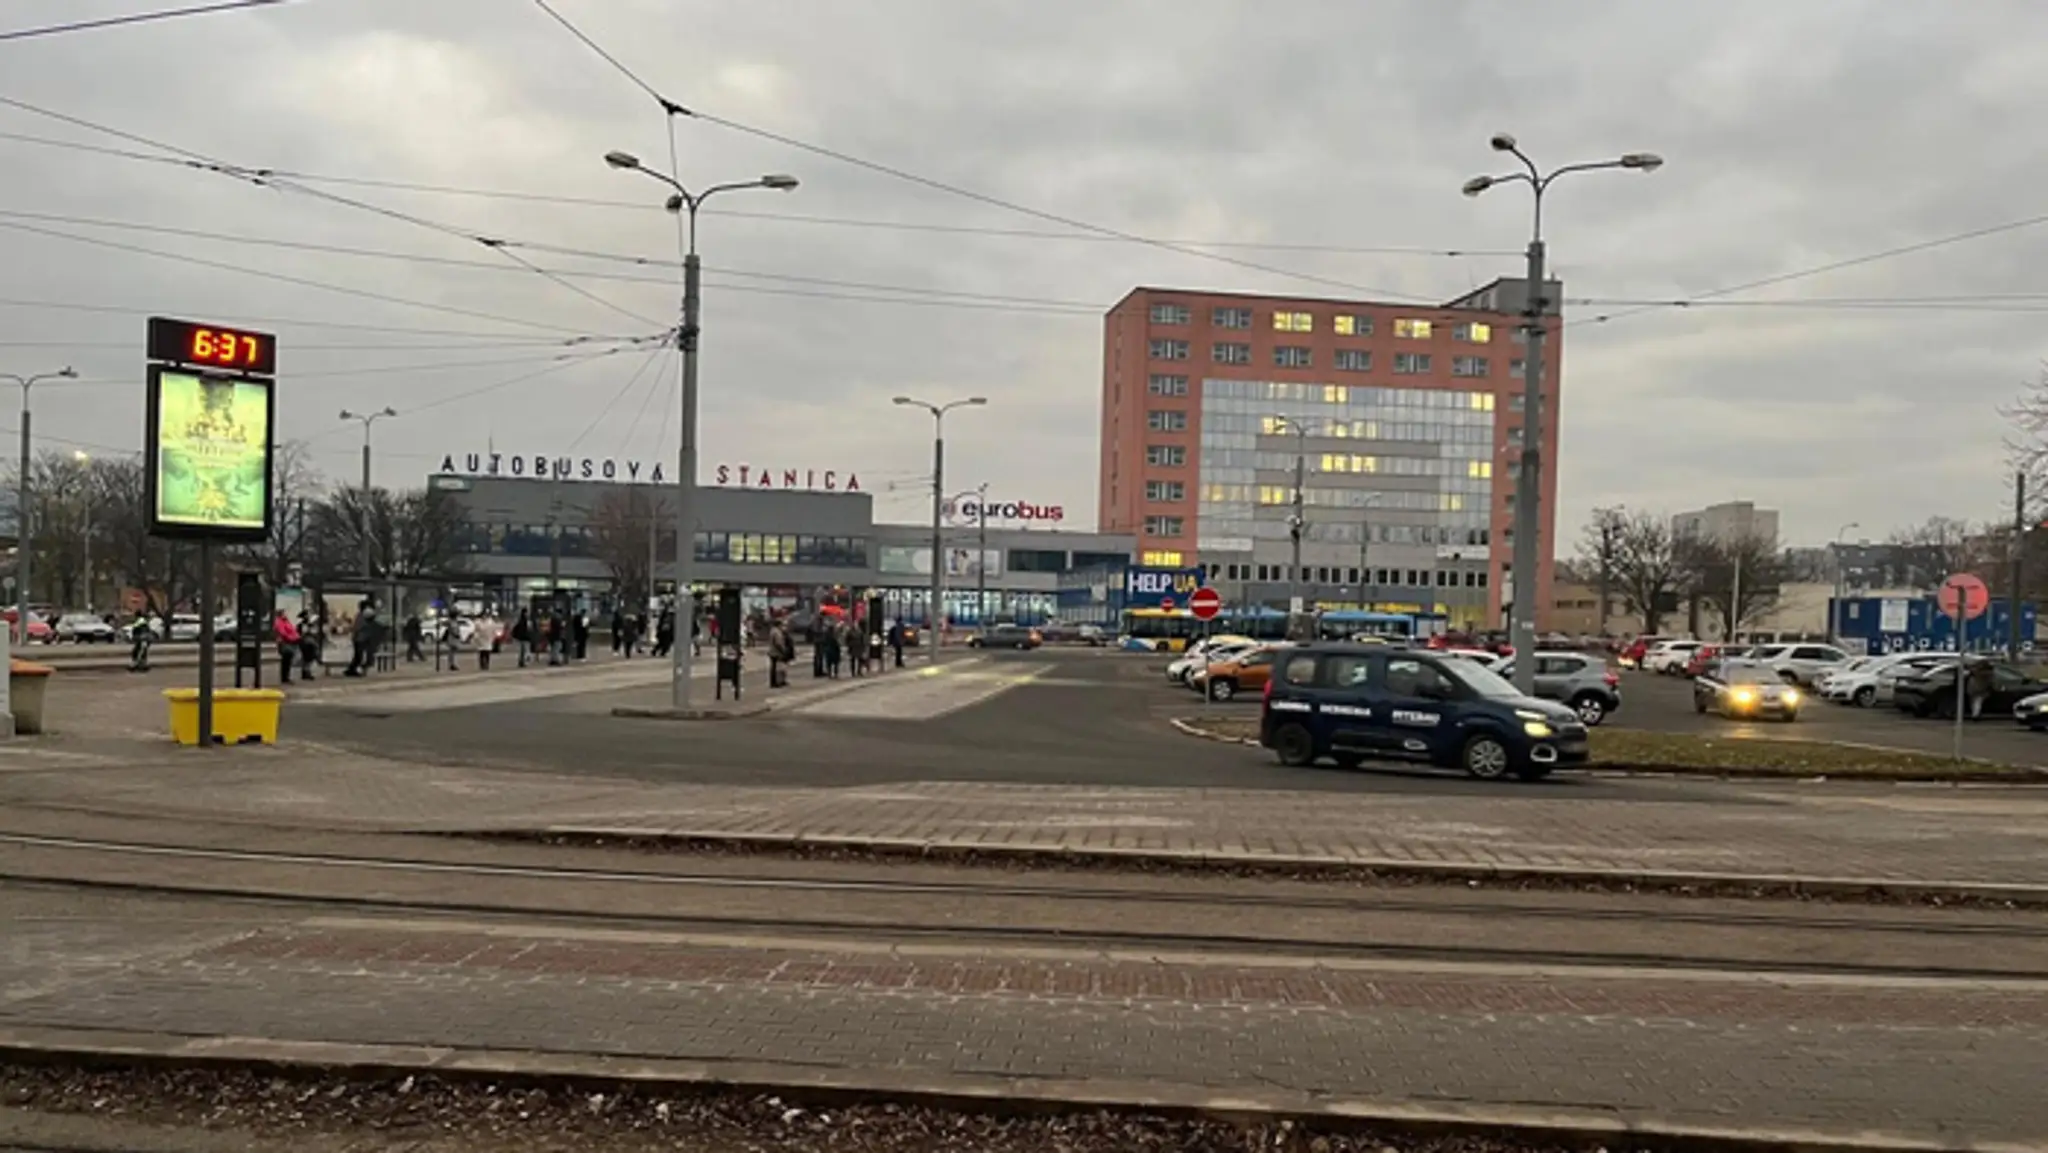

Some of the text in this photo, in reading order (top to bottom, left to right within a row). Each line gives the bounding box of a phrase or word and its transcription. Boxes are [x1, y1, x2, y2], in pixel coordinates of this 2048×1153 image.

[193, 329, 257, 363] 6:37
[717, 465, 859, 492] STANICA
[962, 500, 1063, 522] eurobus
[1128, 573, 1198, 593] HELP UA
